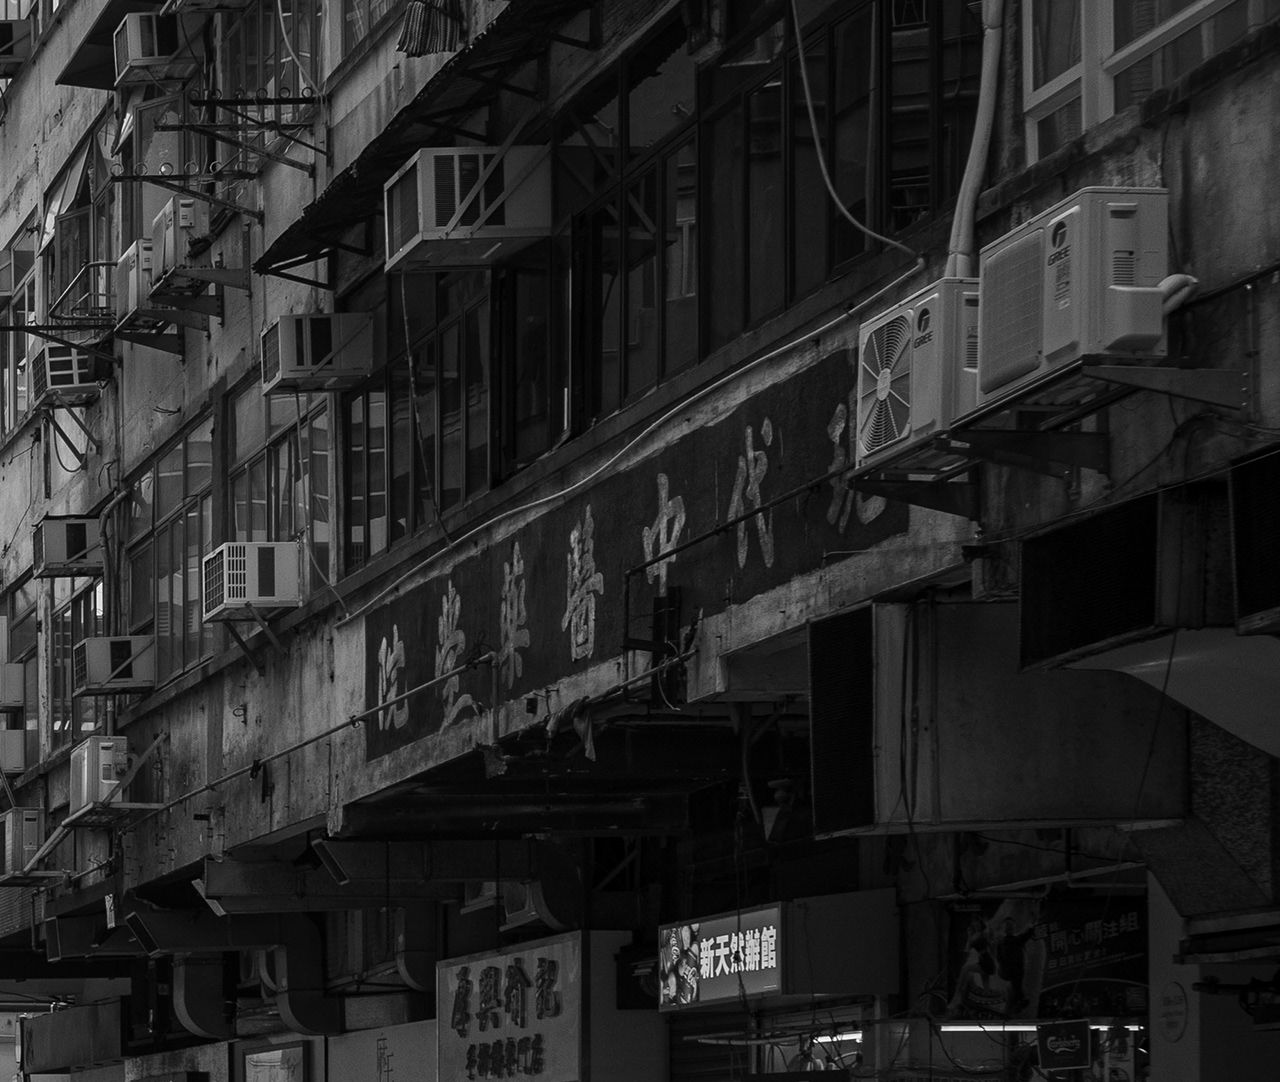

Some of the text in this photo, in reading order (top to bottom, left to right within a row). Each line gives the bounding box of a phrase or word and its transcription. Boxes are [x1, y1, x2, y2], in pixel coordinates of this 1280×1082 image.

[1048, 245, 1071, 266] GREE
[913, 331, 933, 349] GREE
[1047, 1034, 1081, 1053] Carlsberg
